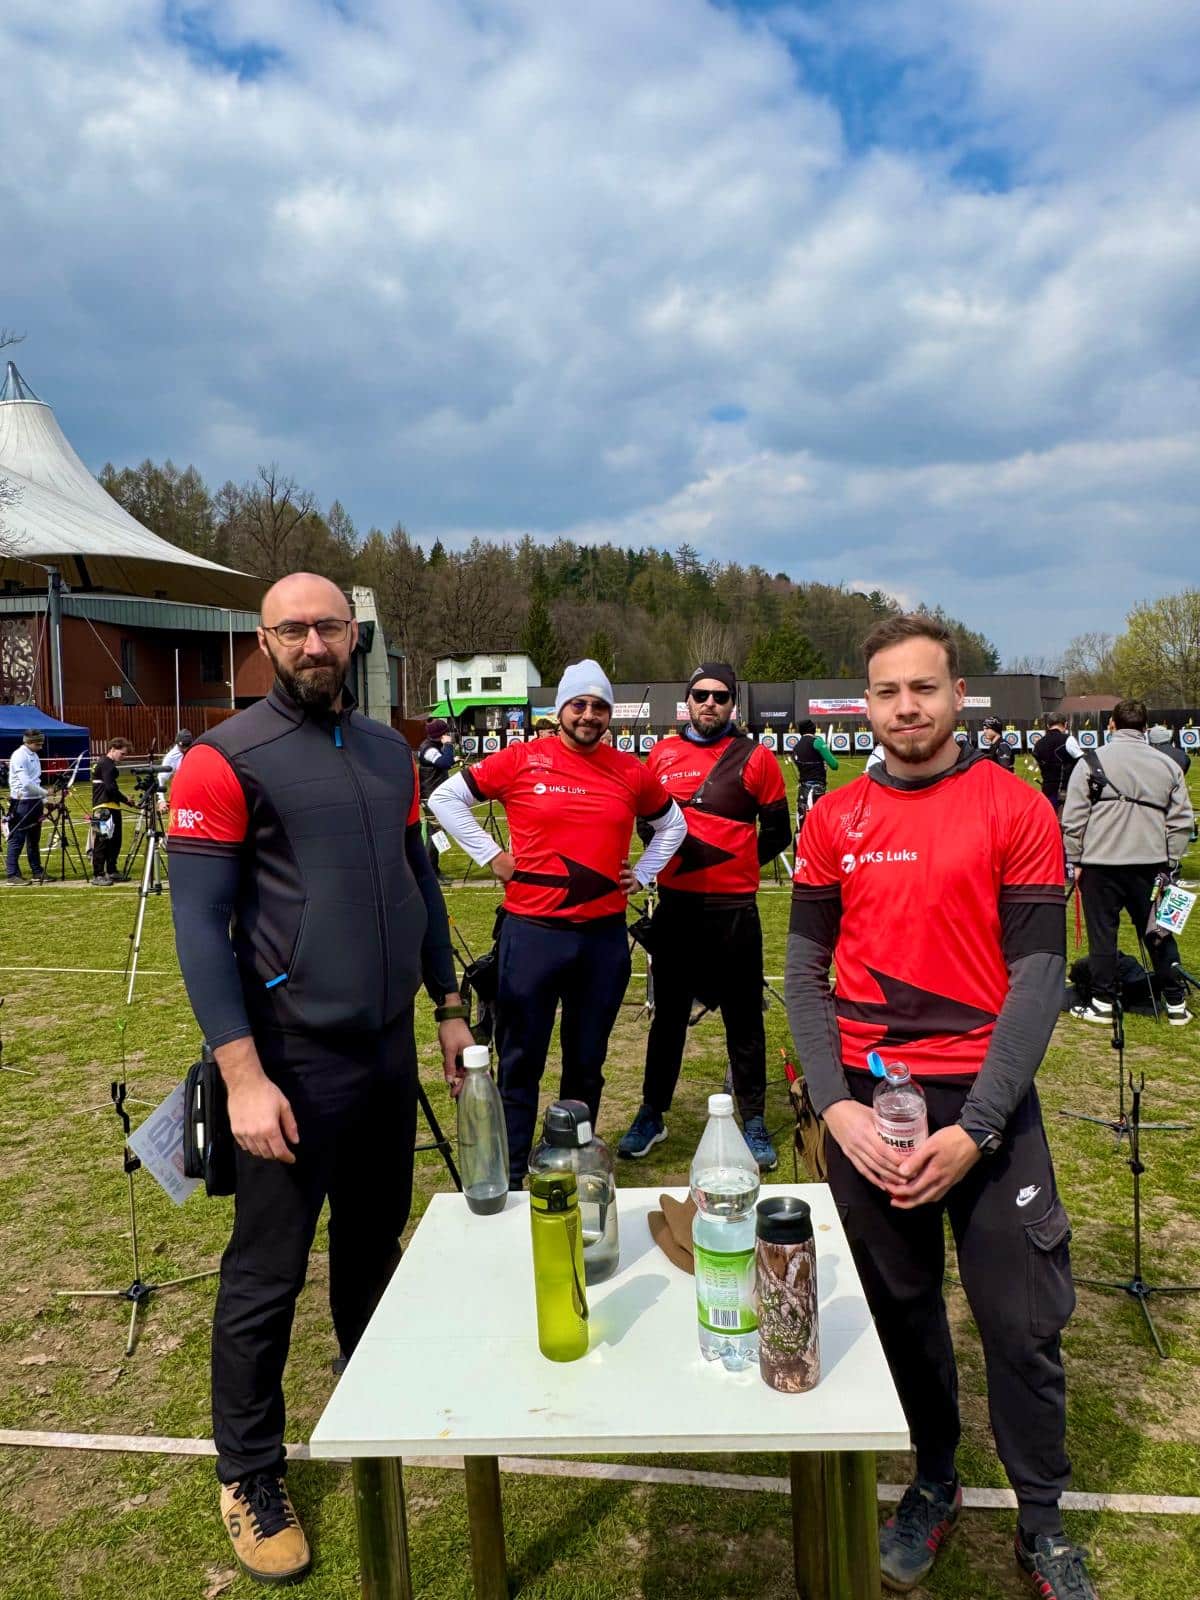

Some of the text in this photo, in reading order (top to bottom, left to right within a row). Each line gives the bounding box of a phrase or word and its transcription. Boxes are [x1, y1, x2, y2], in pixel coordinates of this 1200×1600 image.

[549, 785, 586, 795] UKS Luks
[178, 808, 204, 822] ERGO
[178, 819, 195, 829] TAX
[886, 849, 918, 862] Luks
